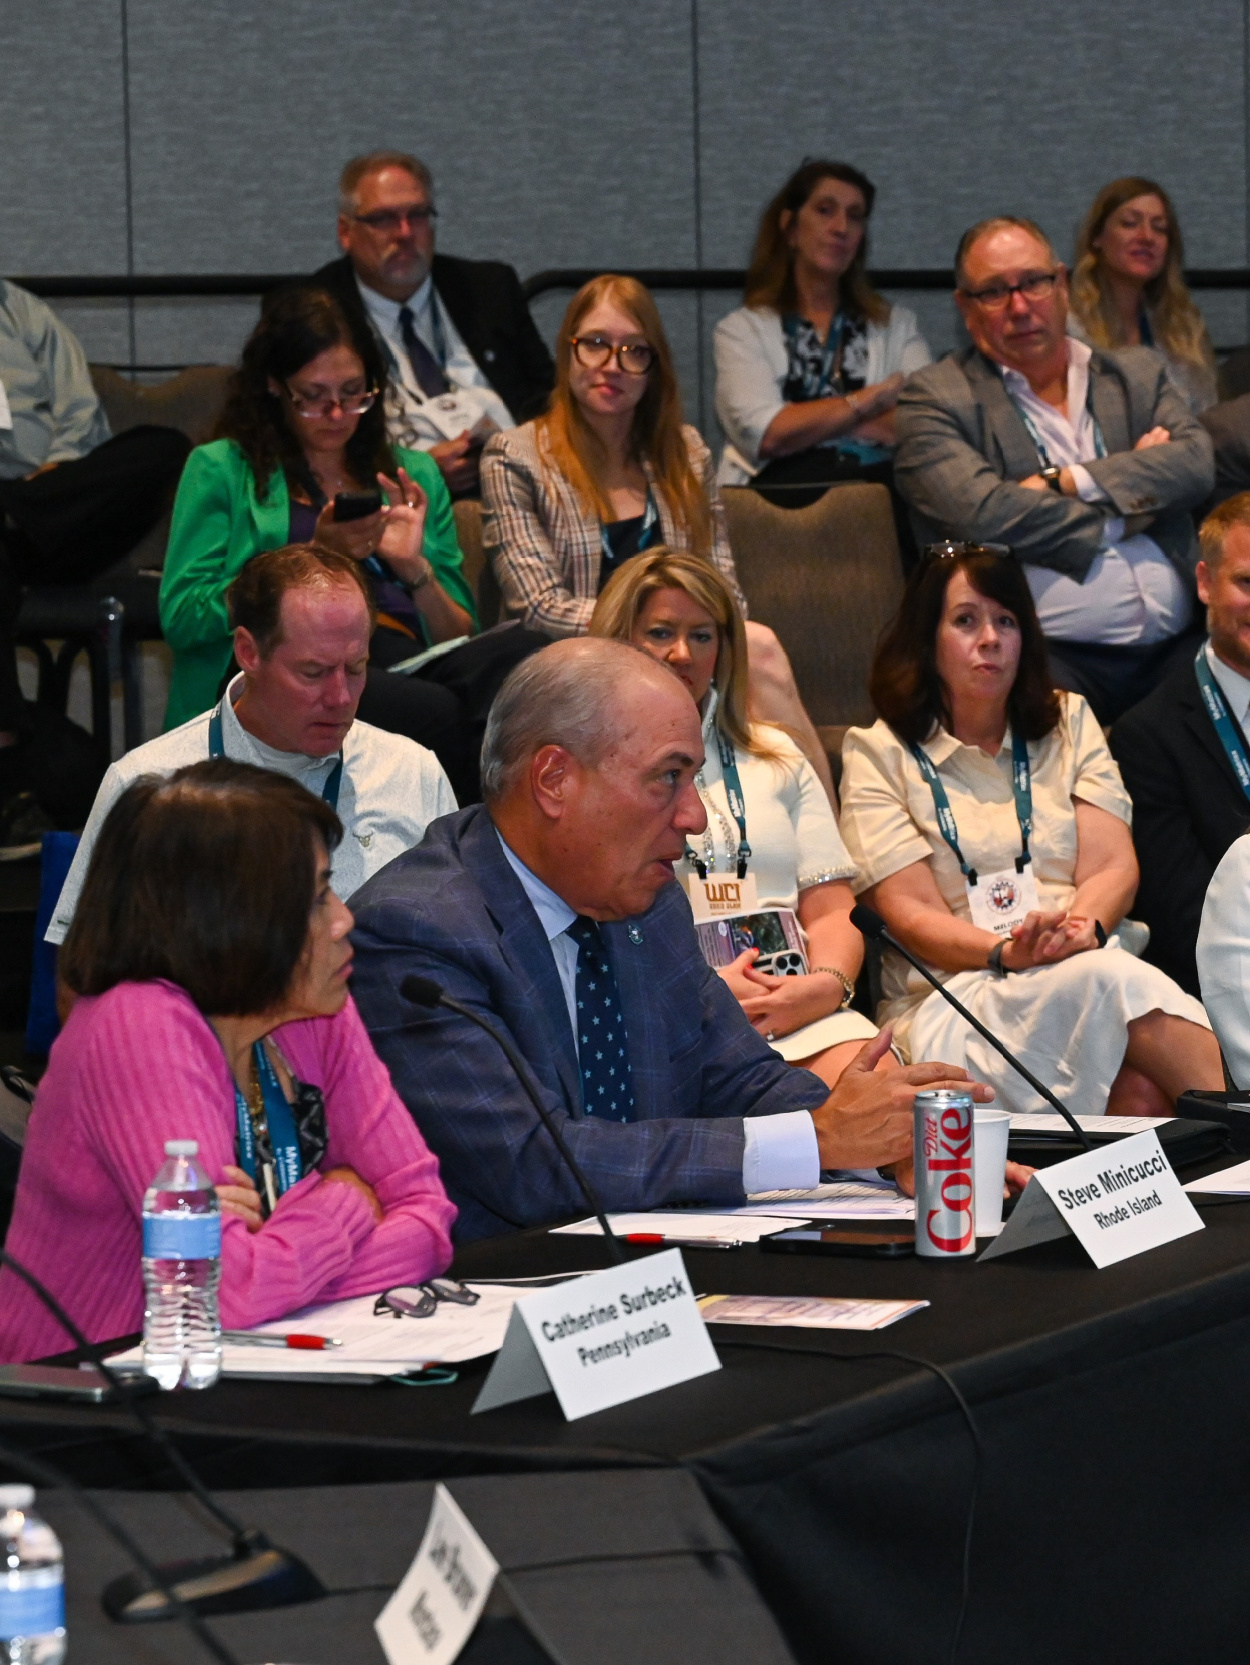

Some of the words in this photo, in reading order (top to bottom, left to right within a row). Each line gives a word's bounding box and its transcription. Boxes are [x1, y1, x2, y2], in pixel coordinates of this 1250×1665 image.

[704, 883, 741, 901] WCI
[923, 1117, 938, 1158] Diet
[926, 1108, 973, 1253] Coke
[1057, 1182, 1102, 1210] Steve
[1097, 1149, 1168, 1195] Minicucci
[1093, 1206, 1131, 1230] Rhode
[1126, 1190, 1163, 1216] Island
[541, 1304, 619, 1342] Catherine
[619, 1276, 687, 1315] Surbeck
[577, 1321, 672, 1367] Pennsylvania
